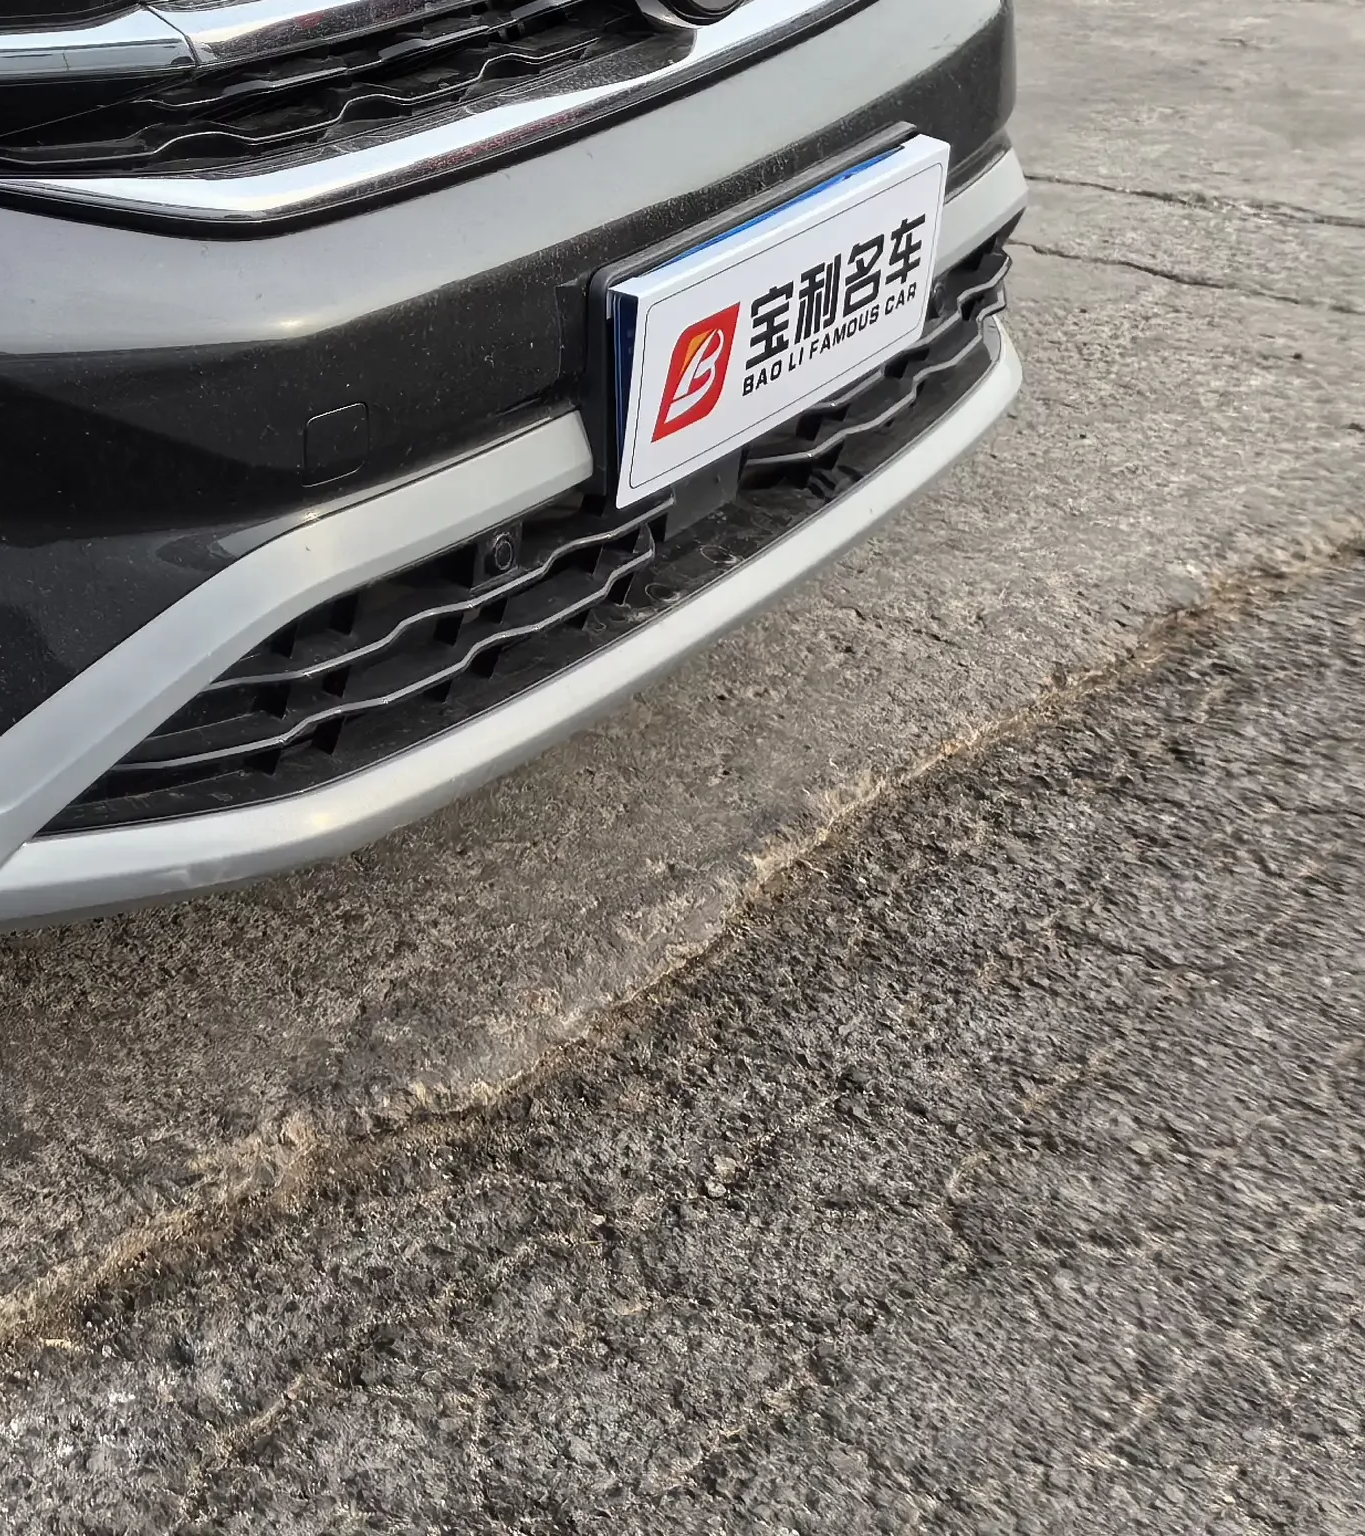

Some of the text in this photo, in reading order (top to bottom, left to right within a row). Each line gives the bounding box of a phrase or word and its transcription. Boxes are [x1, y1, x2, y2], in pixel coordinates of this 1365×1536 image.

[742, 282, 917, 397] BAO LI FAMOUS CAR
[744, 213, 927, 372] 宝利名车
